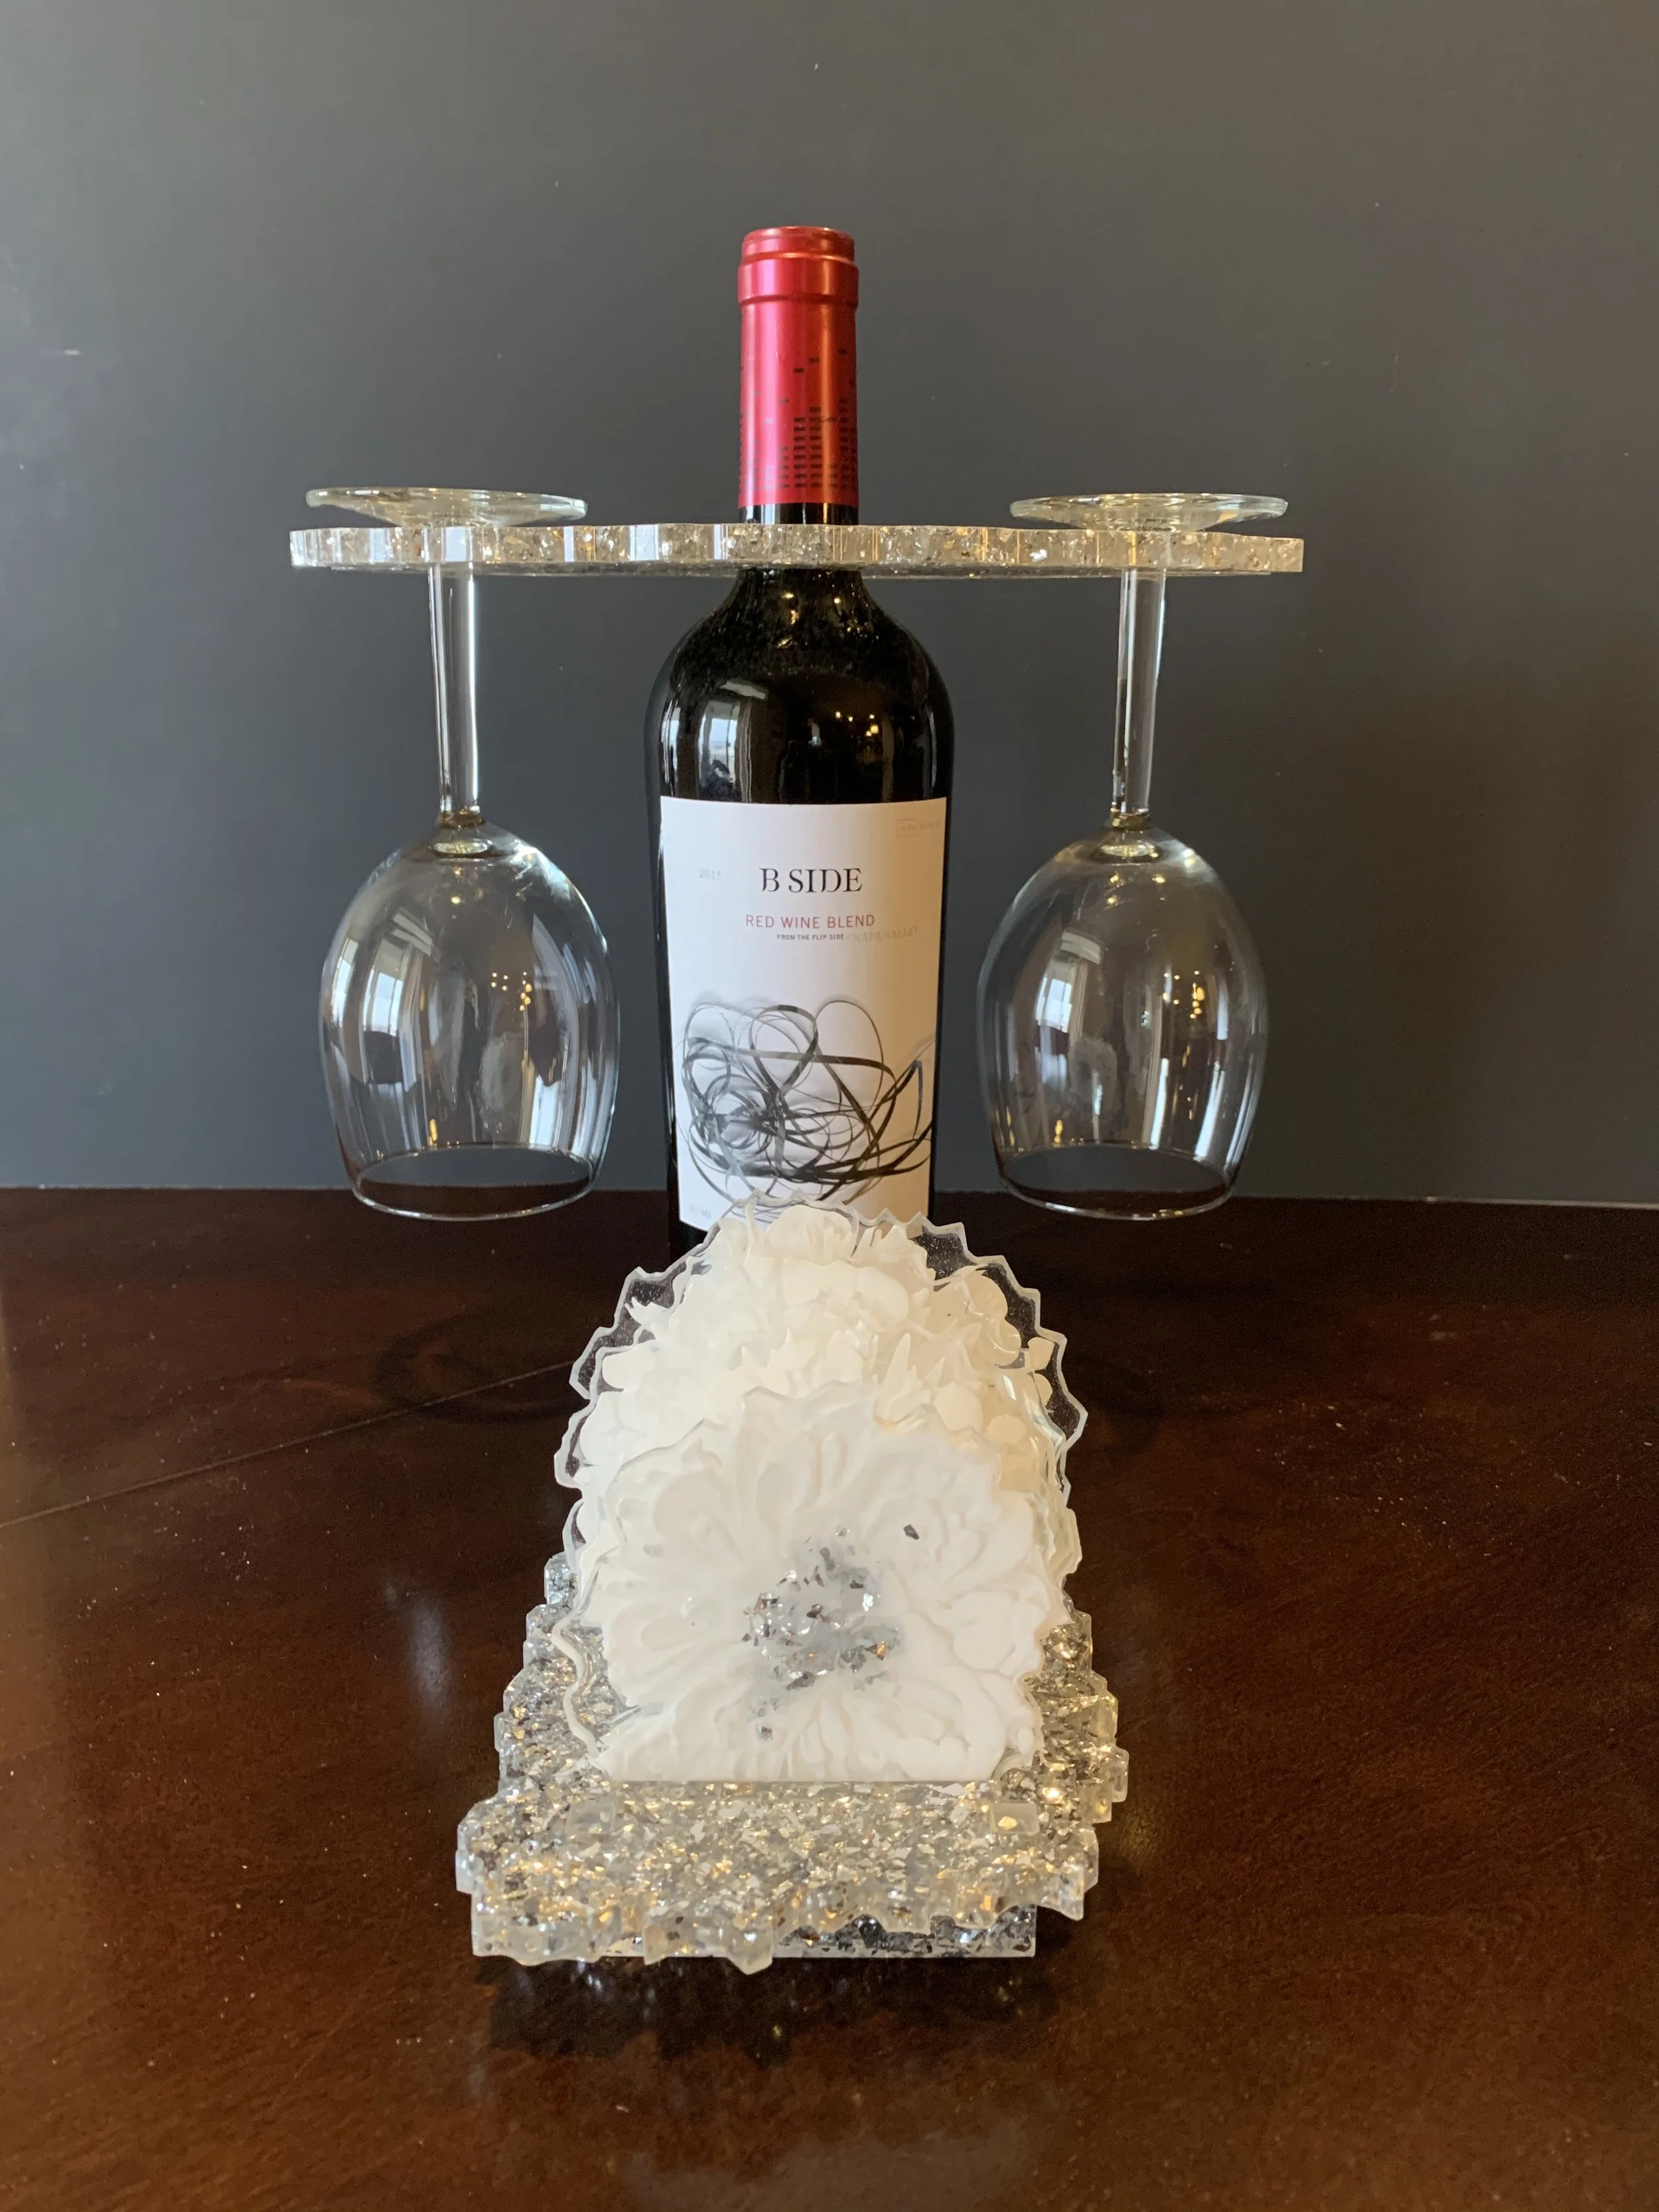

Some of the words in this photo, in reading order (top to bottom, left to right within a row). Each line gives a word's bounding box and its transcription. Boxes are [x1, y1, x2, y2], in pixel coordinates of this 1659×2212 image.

[758, 867, 780, 892] B
[788, 867, 863, 893] SIDE
[745, 914, 774, 928] RED
[780, 915, 820, 928] WINE
[827, 914, 875, 928] BLEND
